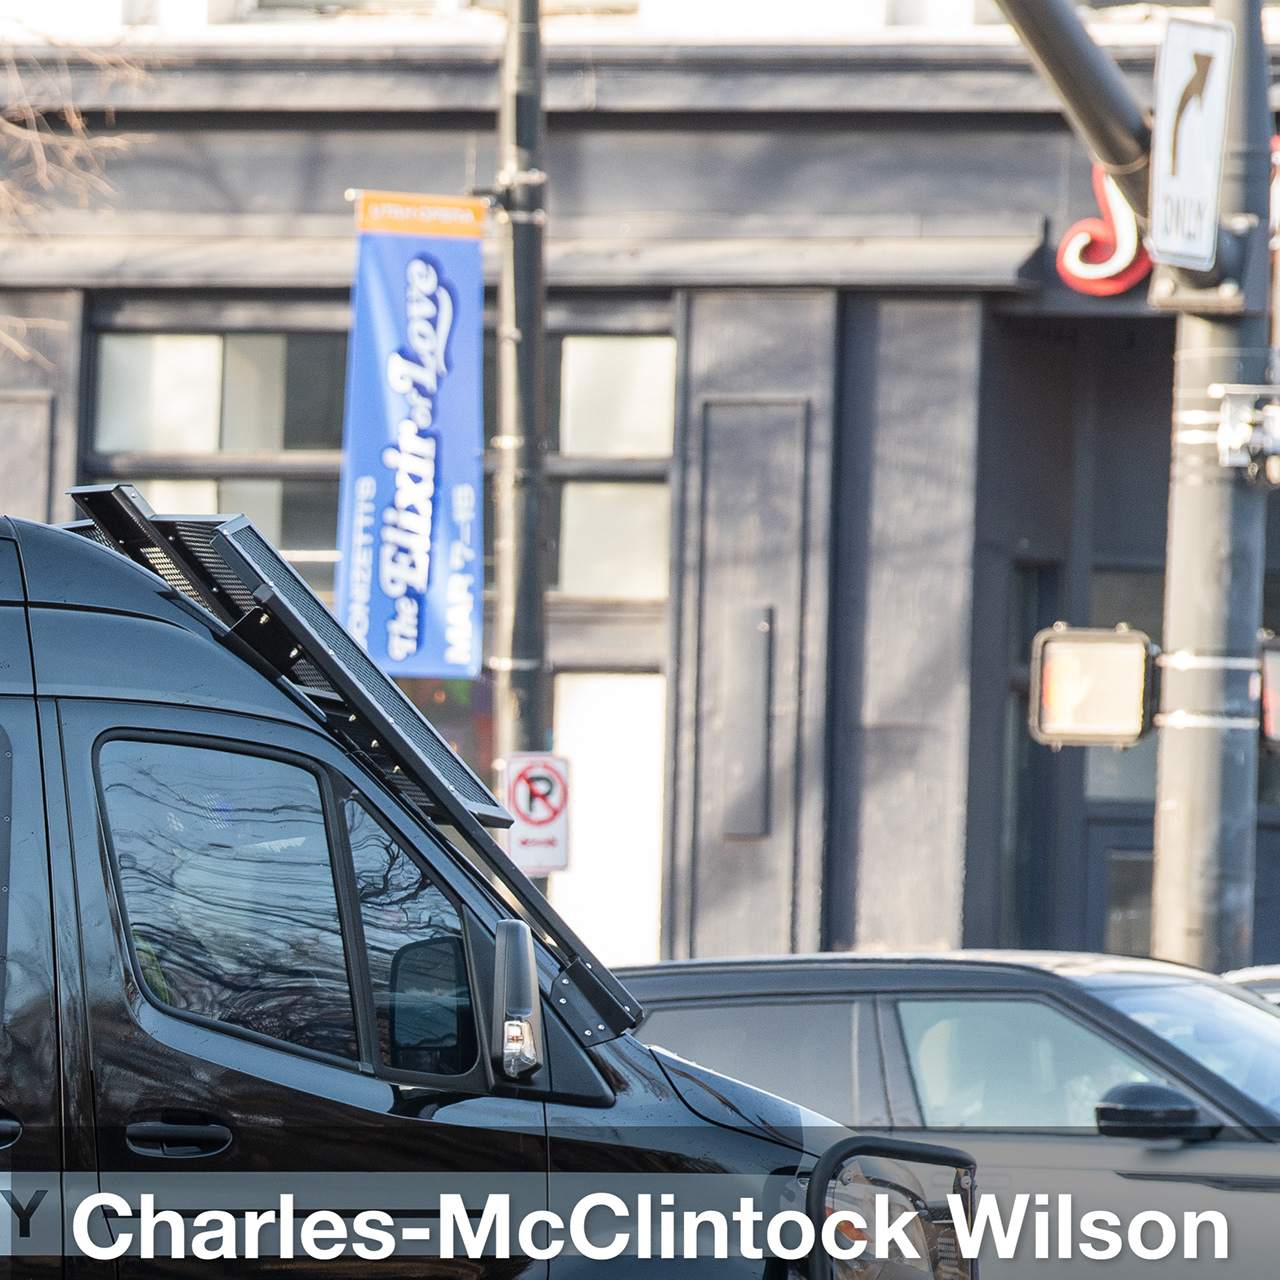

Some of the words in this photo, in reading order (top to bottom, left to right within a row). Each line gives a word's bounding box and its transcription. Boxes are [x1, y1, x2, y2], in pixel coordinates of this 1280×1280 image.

[1162, 193, 1208, 239] ONLY
[387, 258, 454, 393] Love
[406, 387, 433, 429] of
[379, 420, 438, 599] Elixir
[386, 596, 419, 661] The
[444, 573, 475, 665] MAR
